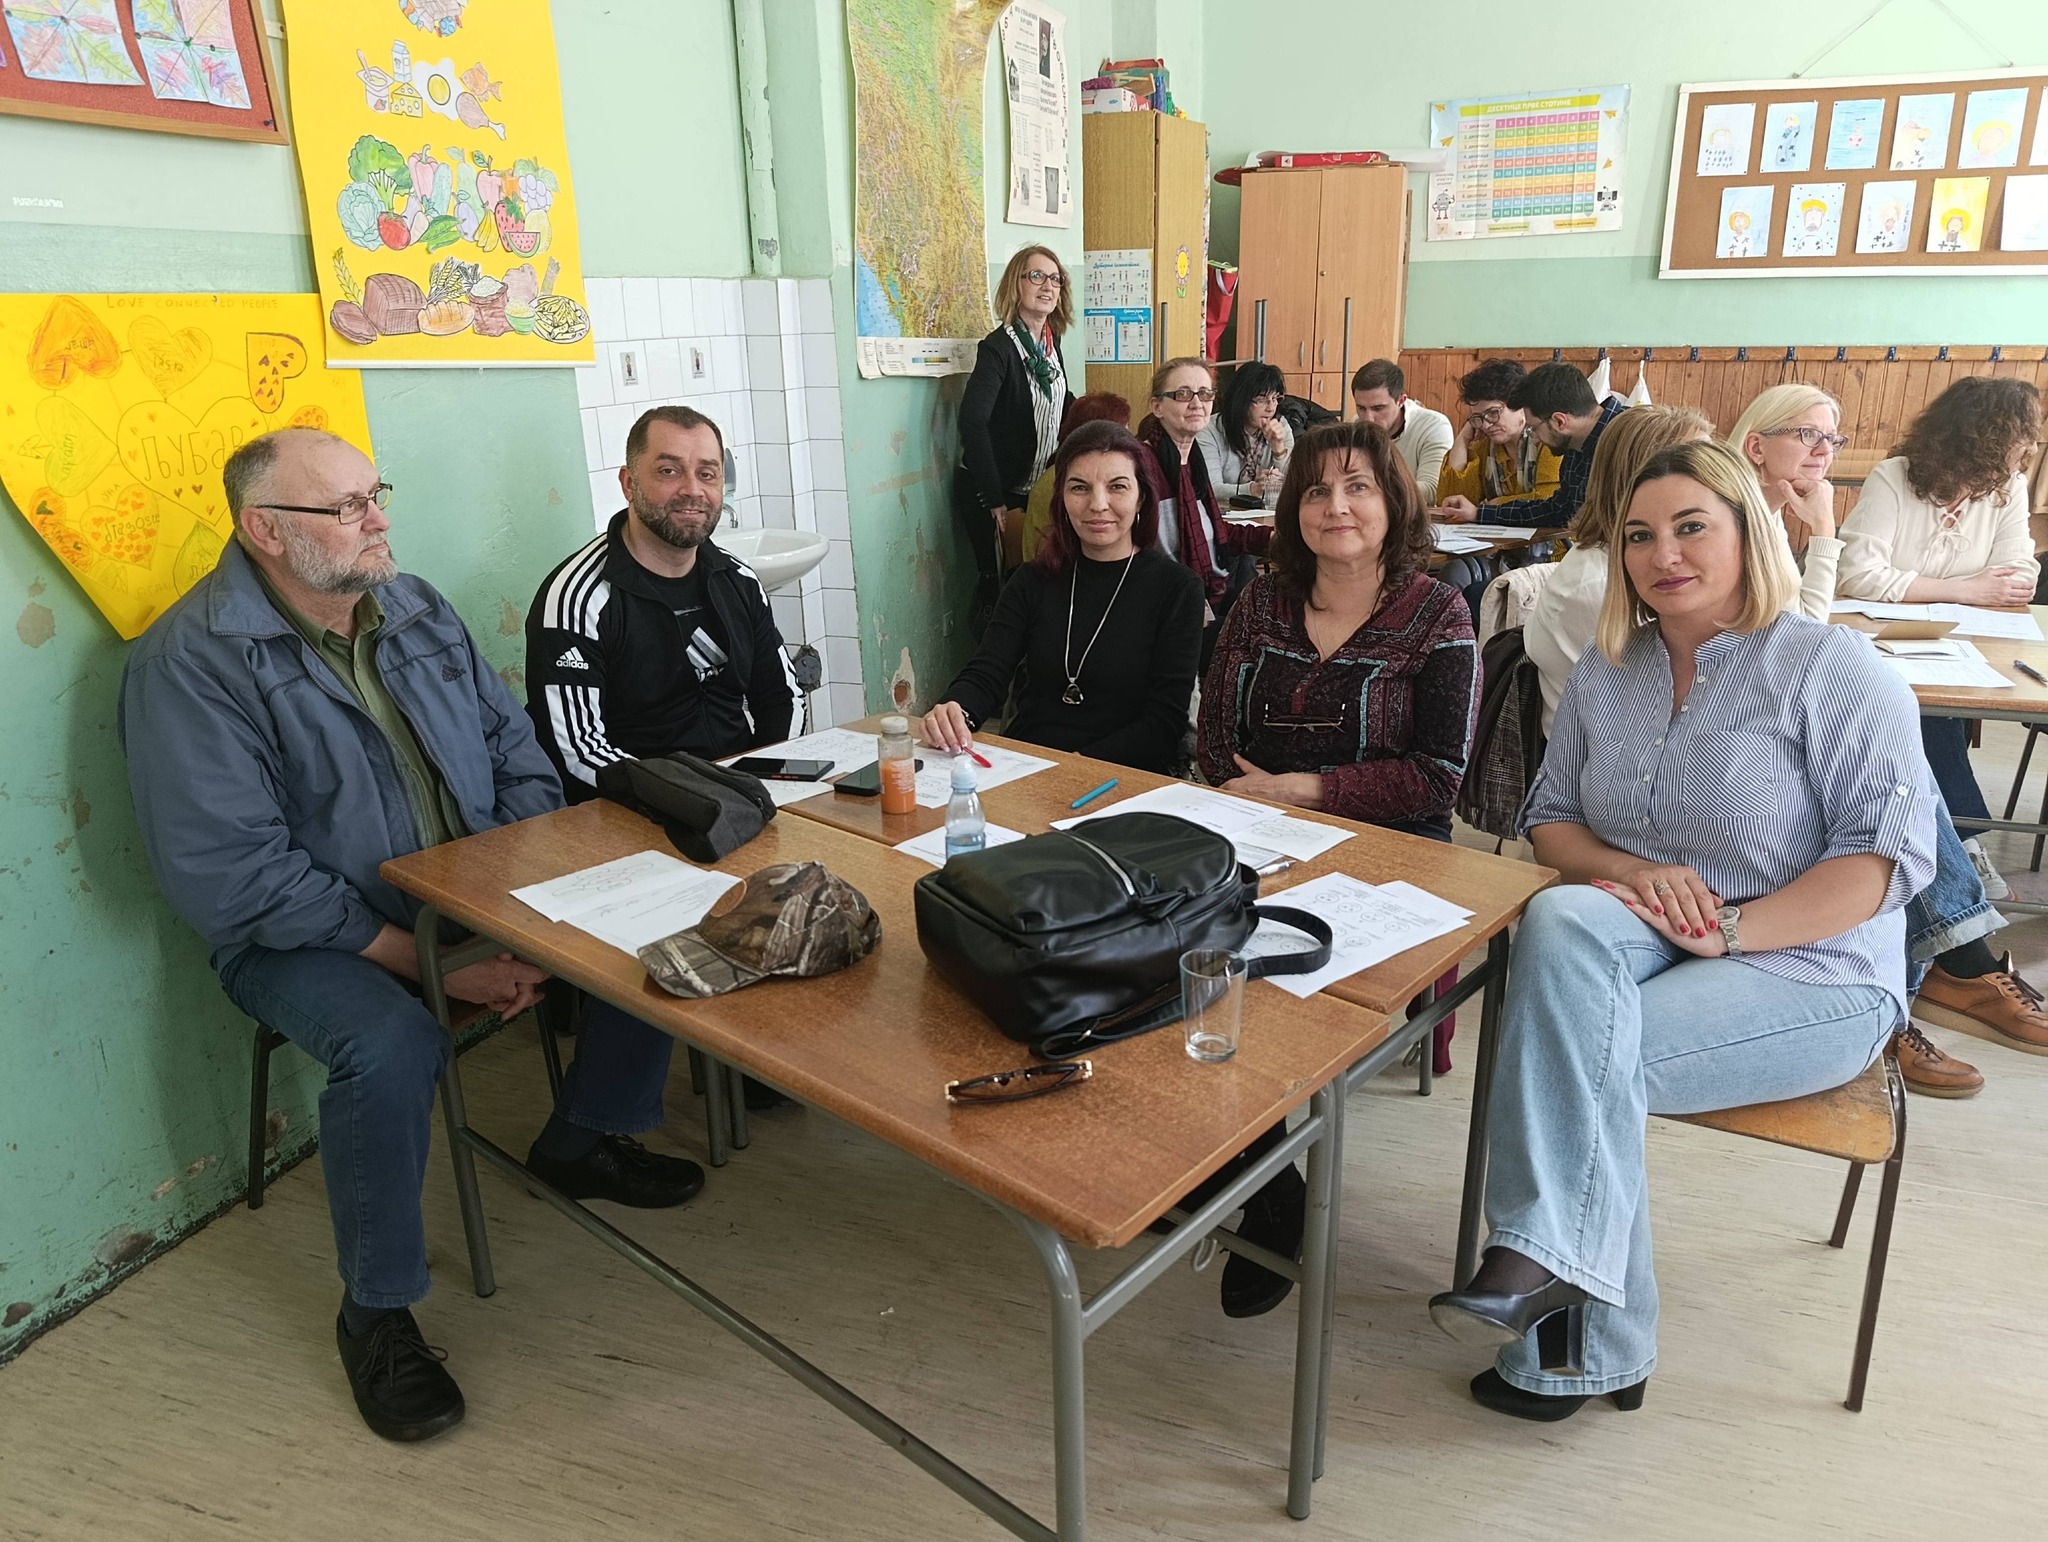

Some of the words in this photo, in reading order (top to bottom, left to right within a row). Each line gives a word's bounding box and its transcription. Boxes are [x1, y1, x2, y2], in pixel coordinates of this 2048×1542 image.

[1487, 104, 1521, 113] ДЕСЕТИЦЕ
[1540, 99, 1571, 108] СТОТИНЕ
[106, 295, 145, 309] LOVE
[156, 297, 235, 309] CONNECTED
[242, 297, 280, 309] PEOPLE
[556, 658, 589, 670] adidas
